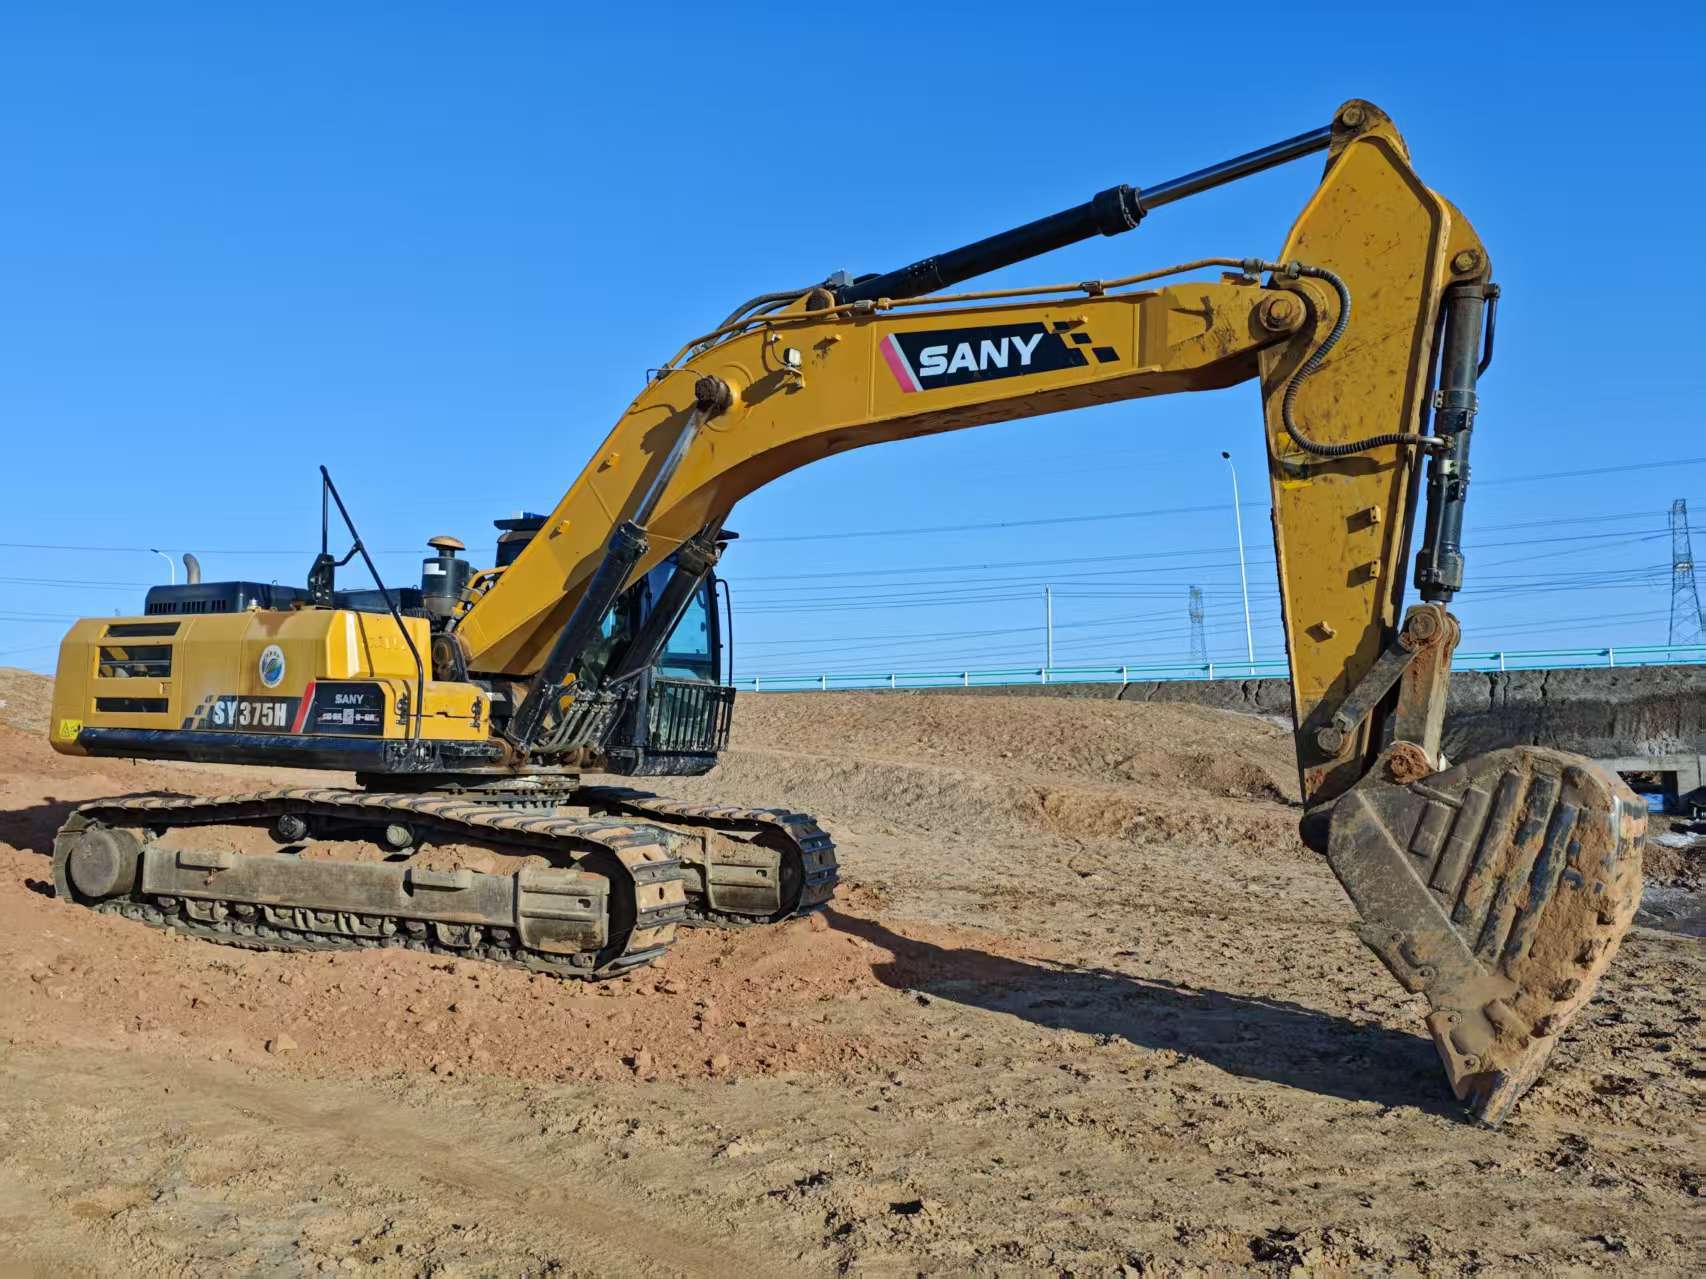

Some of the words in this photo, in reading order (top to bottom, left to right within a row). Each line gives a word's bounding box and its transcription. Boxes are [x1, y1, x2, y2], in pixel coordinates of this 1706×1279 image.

[919, 333, 1044, 377] SANY
[335, 694, 364, 704] SANY
[213, 701, 287, 727] SY375H
